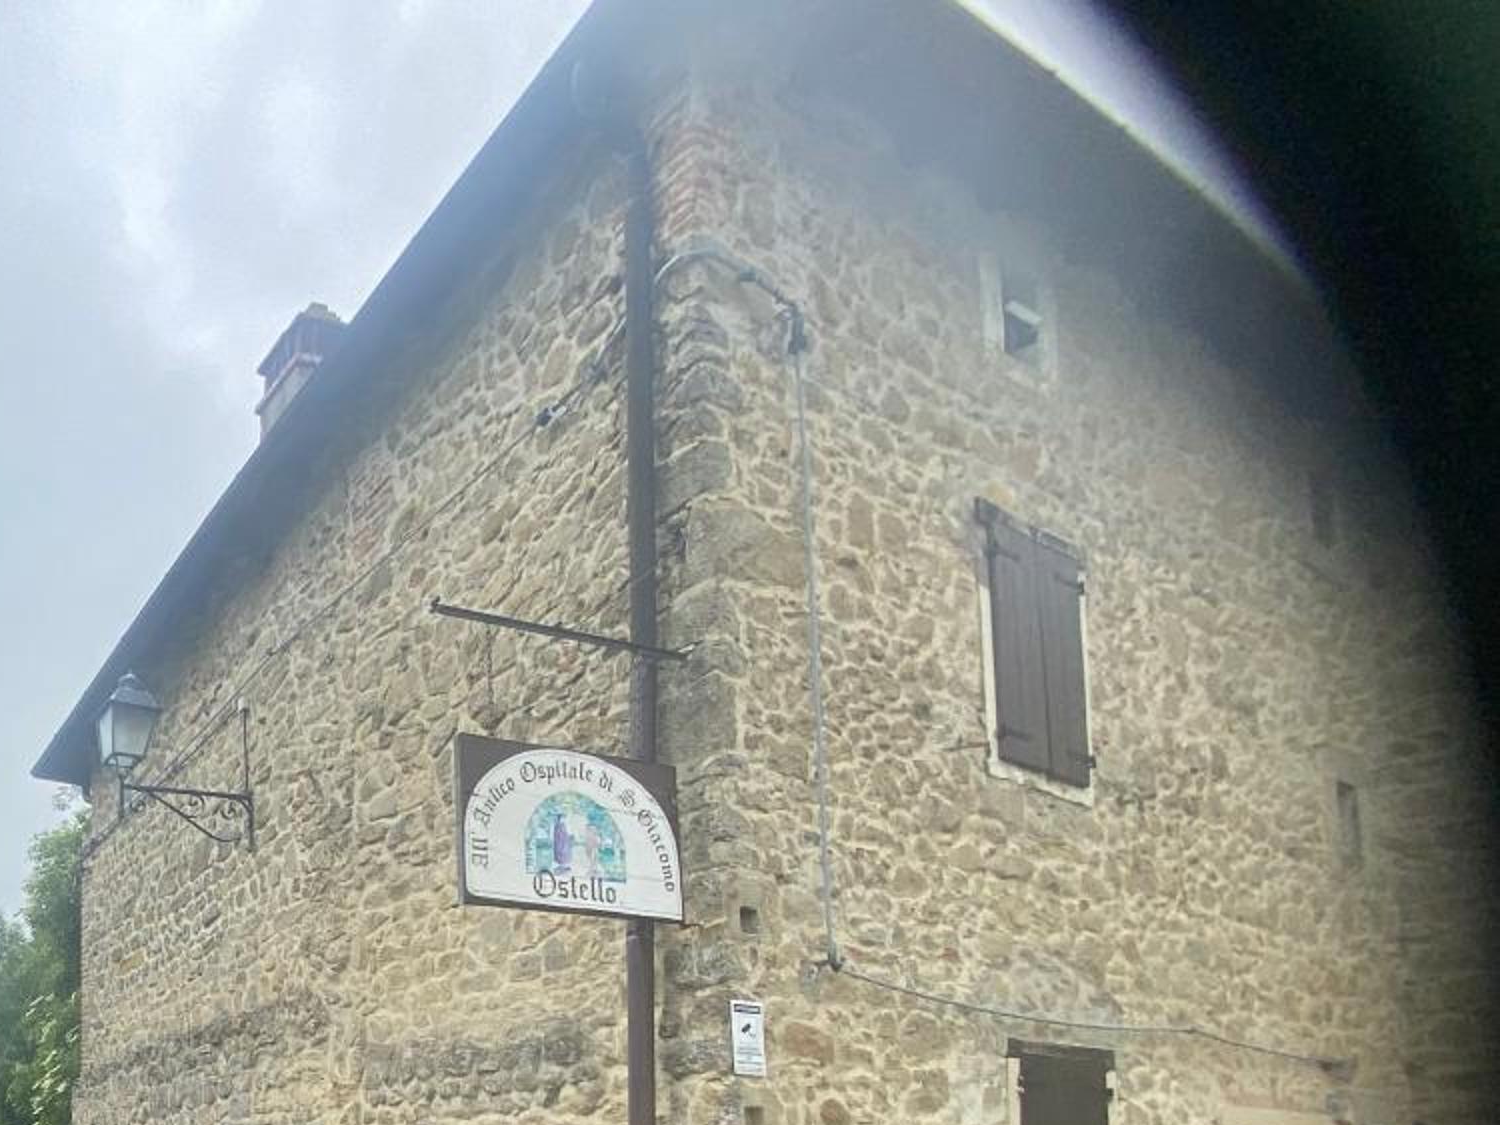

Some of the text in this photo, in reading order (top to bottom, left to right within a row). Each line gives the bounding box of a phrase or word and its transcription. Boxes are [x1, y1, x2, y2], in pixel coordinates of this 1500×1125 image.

[473, 777, 516, 828] Antico
[519, 760, 593, 785] Ospitale
[599, 771, 614, 794] di
[637, 808, 676, 893] Giacomo
[533, 869, 617, 904] Ostello
